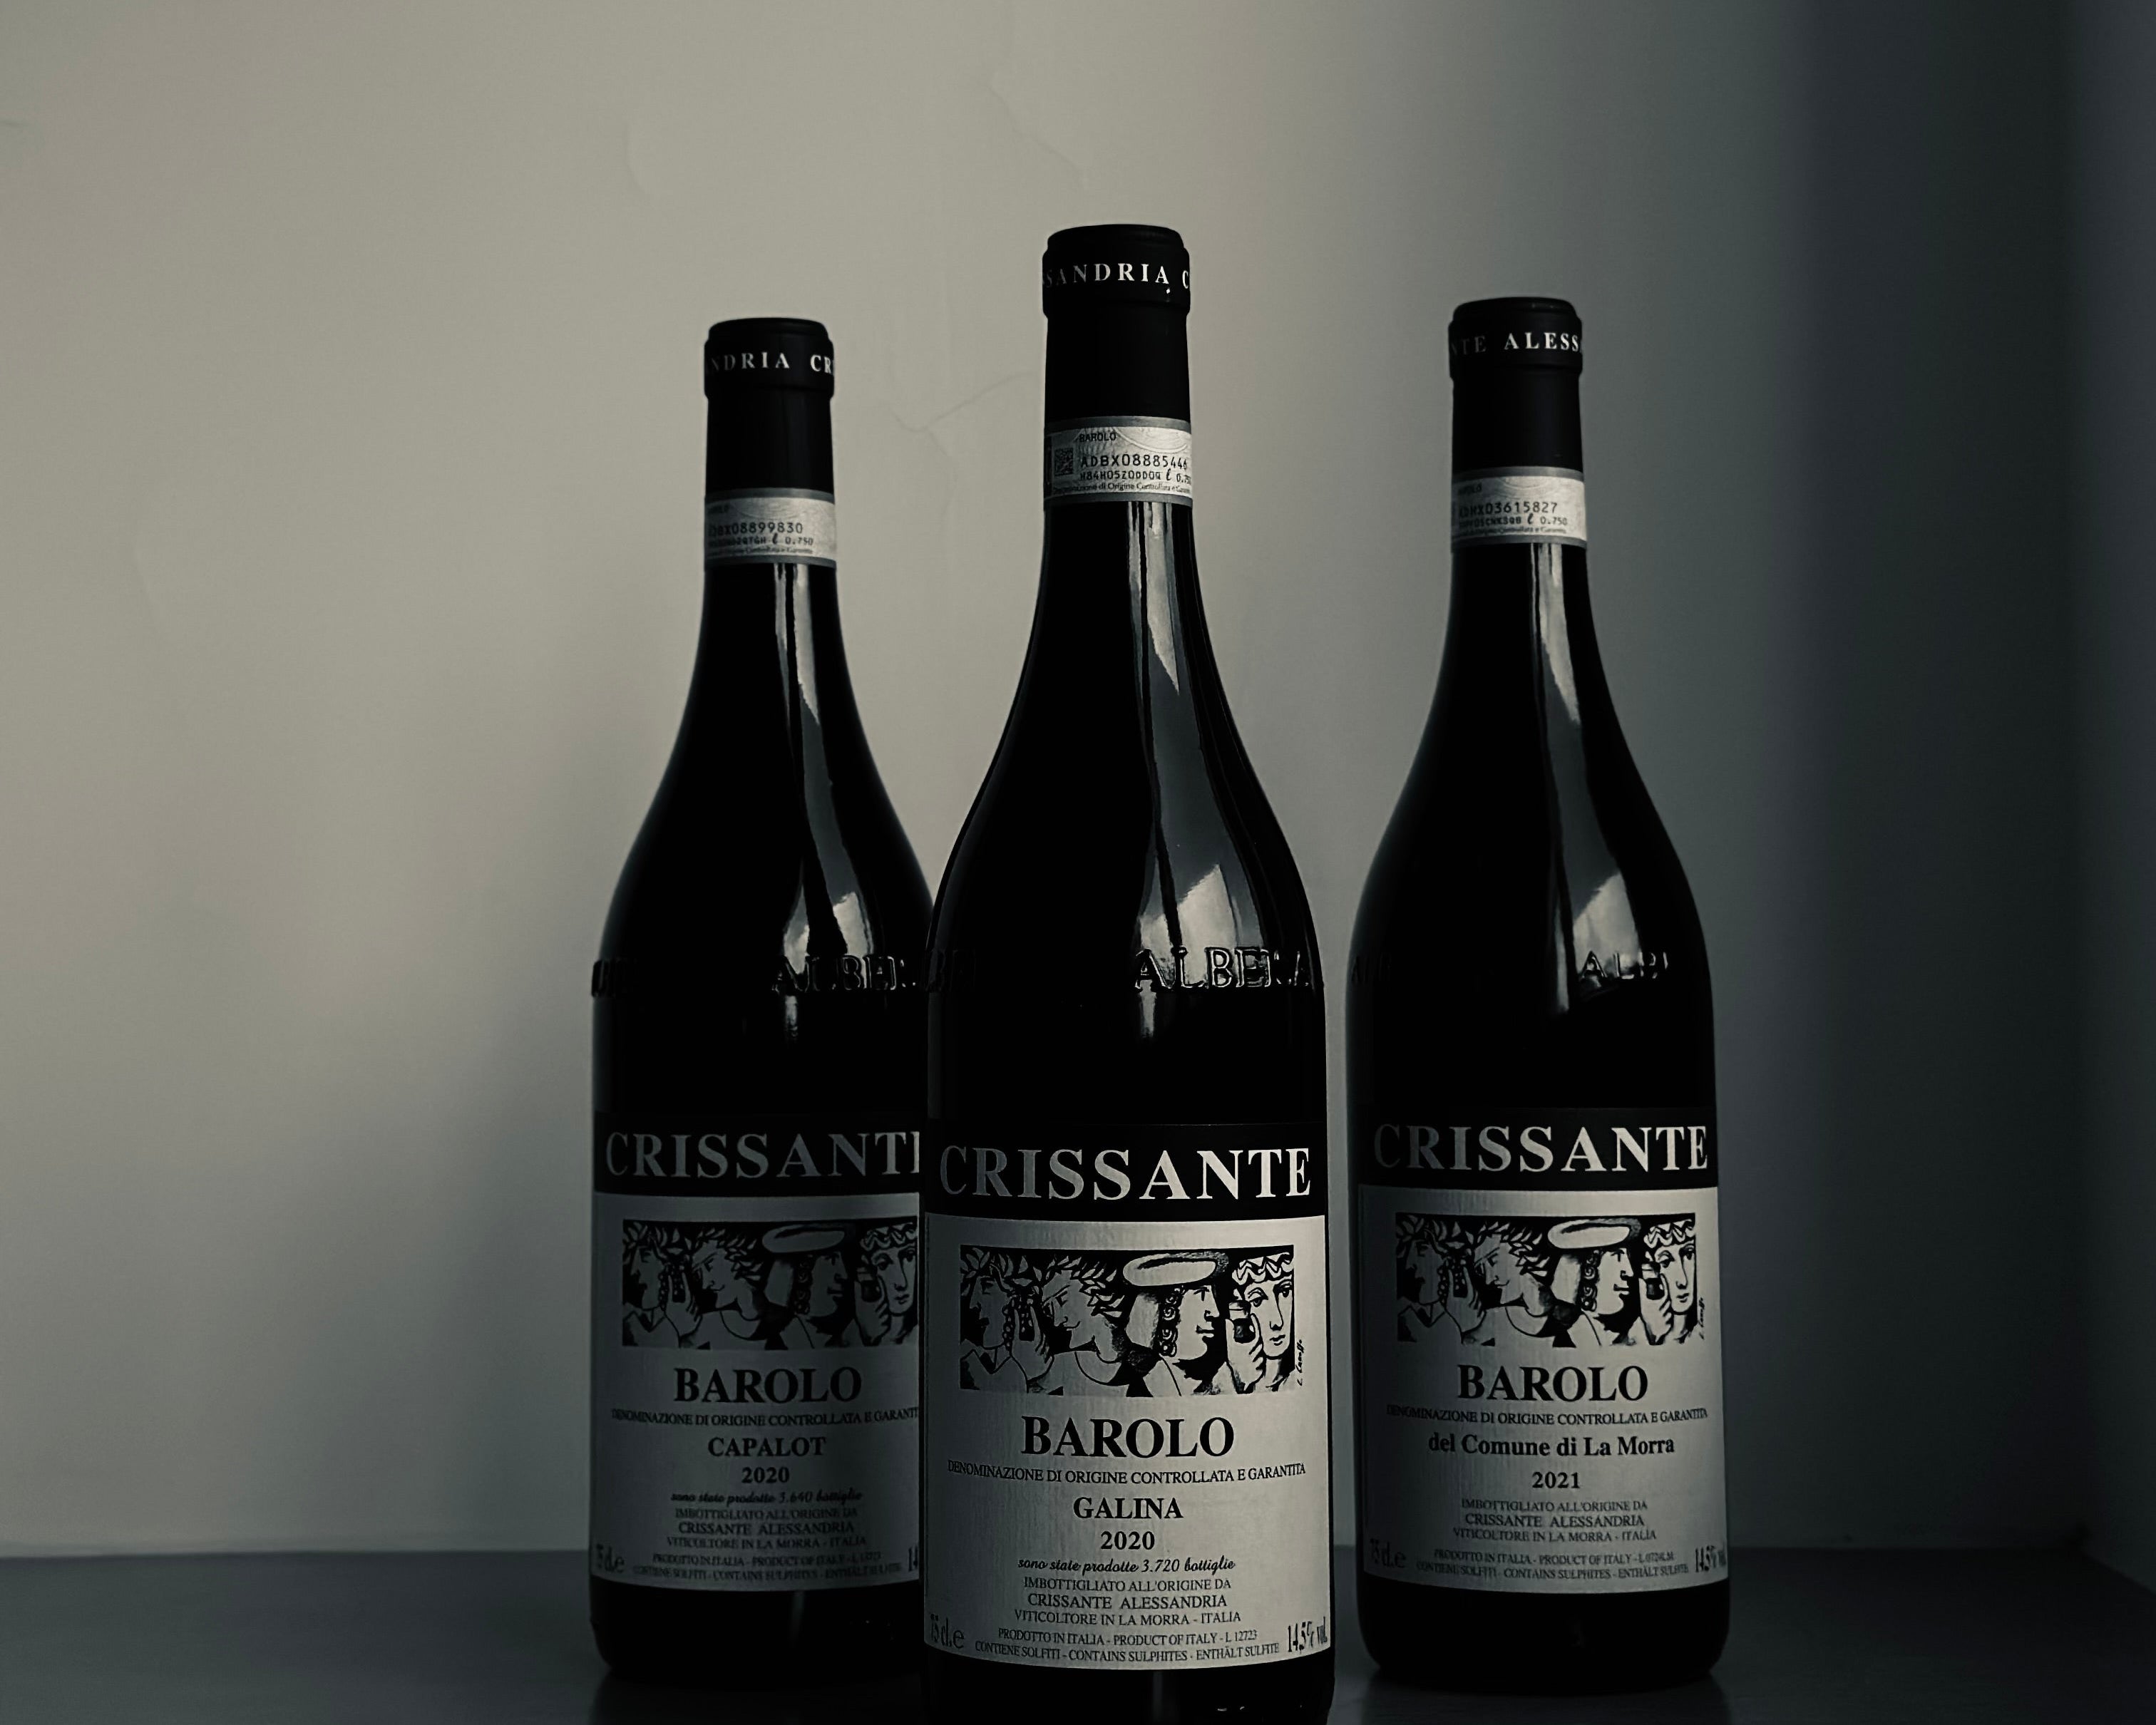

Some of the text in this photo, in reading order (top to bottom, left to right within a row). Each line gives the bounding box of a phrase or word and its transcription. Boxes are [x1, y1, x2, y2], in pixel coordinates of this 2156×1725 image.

[1504, 332, 1579, 351] ALESS
[1079, 433, 1116, 442] BAROLO
[1374, 1123, 1708, 1173] CRISSANTE
[940, 1144, 1312, 1200] CRISSANTE
[674, 1366, 862, 1404] BAROLO
[1457, 1364, 1648, 1401] BAROLO
[695, 1414, 708, 1426] DI
[712, 1414, 766, 1426] ORIGINE
[769, 1412, 862, 1426] CONTROLLATA
[864, 1411, 873, 1423] E
[1481, 1412, 1494, 1423] DI
[1498, 1412, 1555, 1425] ORIGINE
[1558, 1412, 1648, 1425] CONTROLLATA
[1651, 1411, 1659, 1423] E
[1021, 1415, 1234, 1458] BAROLO
[1428, 1432, 1675, 1456] del Comune di La Morra
[708, 1437, 826, 1457] CAPALOT
[741, 1466, 790, 1483] 2020
[948, 1459, 1306, 1484] DENOMINAZIONE DI ORIGINE CONTROLLATA E GARANTITA
[1532, 1471, 1580, 1489] 2021
[675, 1508, 764, 1520] IMBOTTIGLIATO
[1073, 1496, 1184, 1520] GALINA
[1462, 1498, 1648, 1513] IMBOTTIGLIATO ALL'ORIGINE DA
[679, 1521, 855, 1535] CRISSANTE ALESSANDRIA
[1465, 1513, 1645, 1528] CRISSANTE ALESSANDRIA
[741, 1538, 754, 1549] IN
[756, 1538, 773, 1549] LA
[776, 1537, 820, 1549] MORRA
[830, 1535, 867, 1547] ITALIA
[1101, 1531, 1155, 1550] 2020
[1453, 1528, 1657, 1543] VITICOLTORE IN LA MORRA ITALIA
[1018, 1555, 1236, 1576] sono state prodotte 3.720 bottiglie
[1497, 1553, 1531, 1565] ITALIA
[1539, 1555, 1587, 1565] PRODUCT
[1589, 1555, 1602, 1565] OF
[1604, 1552, 1632, 1565] ITALY
[1503, 1568, 1556, 1580] CONTAINS
[1558, 1568, 1612, 1580] SULPHITES
[1024, 1575, 1231, 1592] IMBOTTIGLIATO ALL'ORIGINE DA
[1027, 1592, 1227, 1610] CRISSANTE ALESSANDRIA
[1014, 1608, 1241, 1627] VITICOLTORE IN LA MORRA ITALIA
[998, 1627, 1052, 1643] PRODOTTO
[1054, 1631, 1066, 1644] IN
[1067, 1632, 1105, 1646] ITALIA
[1114, 1634, 1167, 1646] PRODUCT
[1169, 1634, 1184, 1646] OF
[1186, 1632, 1218, 1645] ITALY
[975, 1640, 1020, 1657] CONTIENE
[1021, 1647, 1060, 1660] SOLFITI
[1069, 1649, 1126, 1662] CONTAINS
[1129, 1649, 1188, 1662] SULPHITES
[1244, 1642, 1280, 1656] SULFITE
